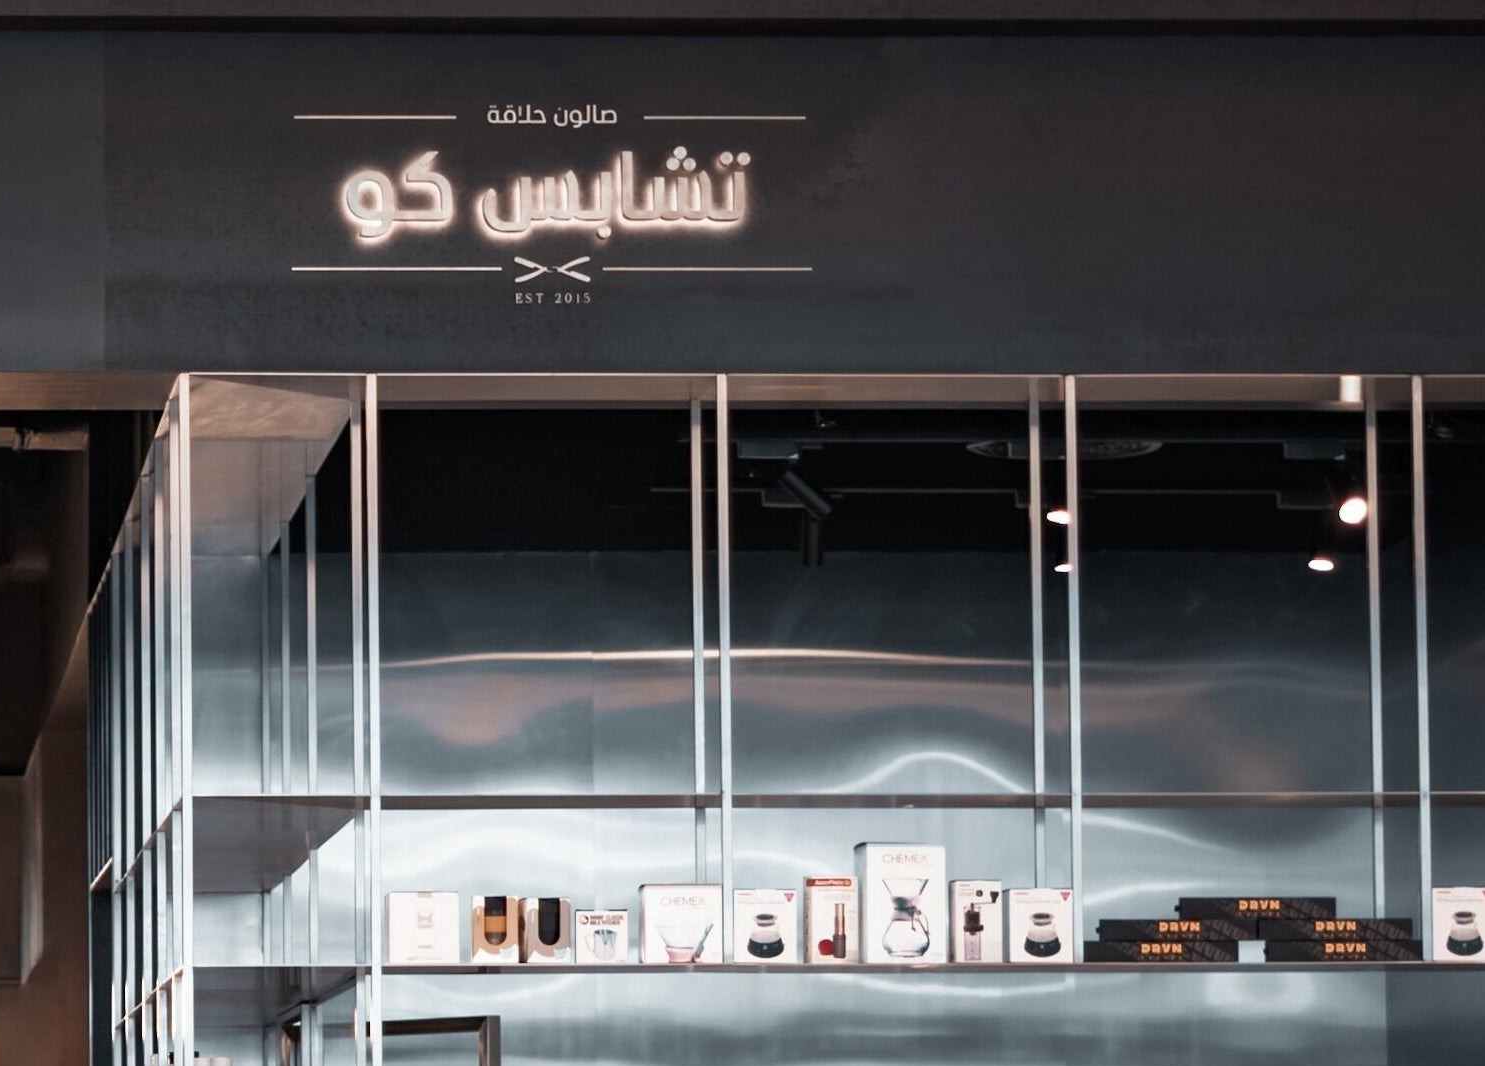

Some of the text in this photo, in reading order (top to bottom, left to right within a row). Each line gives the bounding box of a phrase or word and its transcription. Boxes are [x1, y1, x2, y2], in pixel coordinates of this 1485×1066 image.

[486, 104, 618, 128] صالون حلاقة
[345, 145, 751, 240] تشابس كو
[515, 293, 591, 304] EST 2015
[882, 854, 930, 864] CHEMEX
[660, 896, 706, 906] CHEMEX
